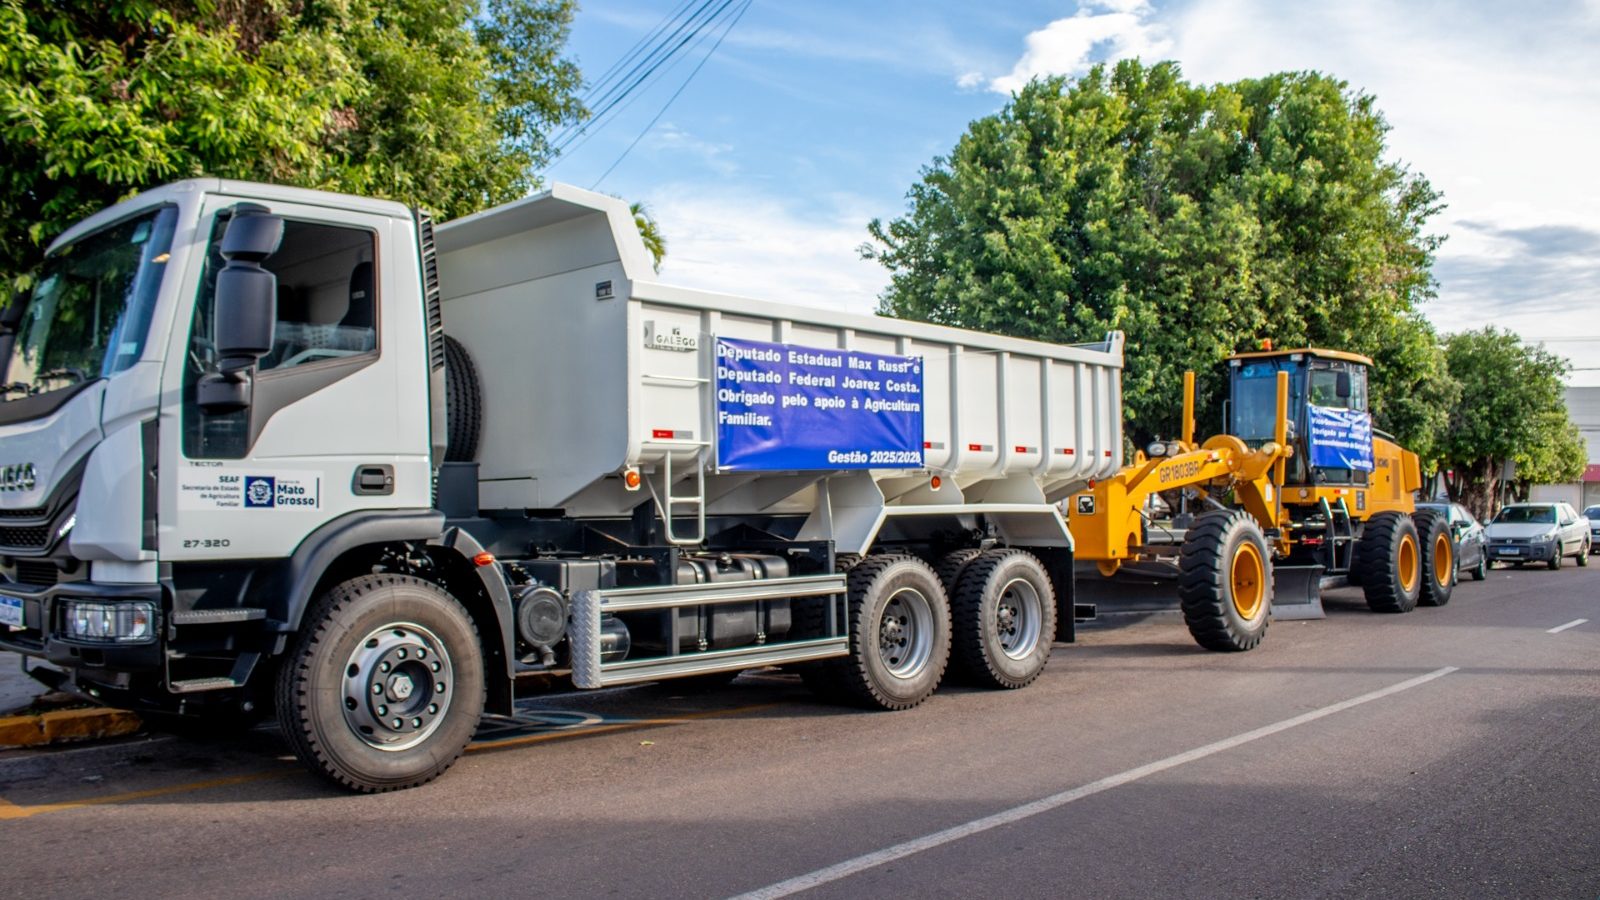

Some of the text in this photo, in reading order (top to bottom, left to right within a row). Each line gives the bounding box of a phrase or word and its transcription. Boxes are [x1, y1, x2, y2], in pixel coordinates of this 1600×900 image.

[656, 335, 696, 347] GALEGO
[717, 344, 781, 362] Deputado
[788, 351, 842, 368] Estadual
[848, 357, 872, 370] Max
[913, 364, 920, 374] e
[717, 366, 920, 393] Deputado Federal Joarez Costa.
[718, 389, 775, 406] Obrigado
[782, 393, 808, 408] pelo
[814, 395, 846, 410] apoio
[864, 398, 920, 413] Agricultura
[719, 411, 772, 426] Familiar.
[828, 450, 921, 463] Gestão 2025/2028
[219, 475, 240, 483] SEAF
[277, 485, 305, 495] Mato
[277, 495, 315, 505] Grosso
[183, 539, 230, 548] 27-320
